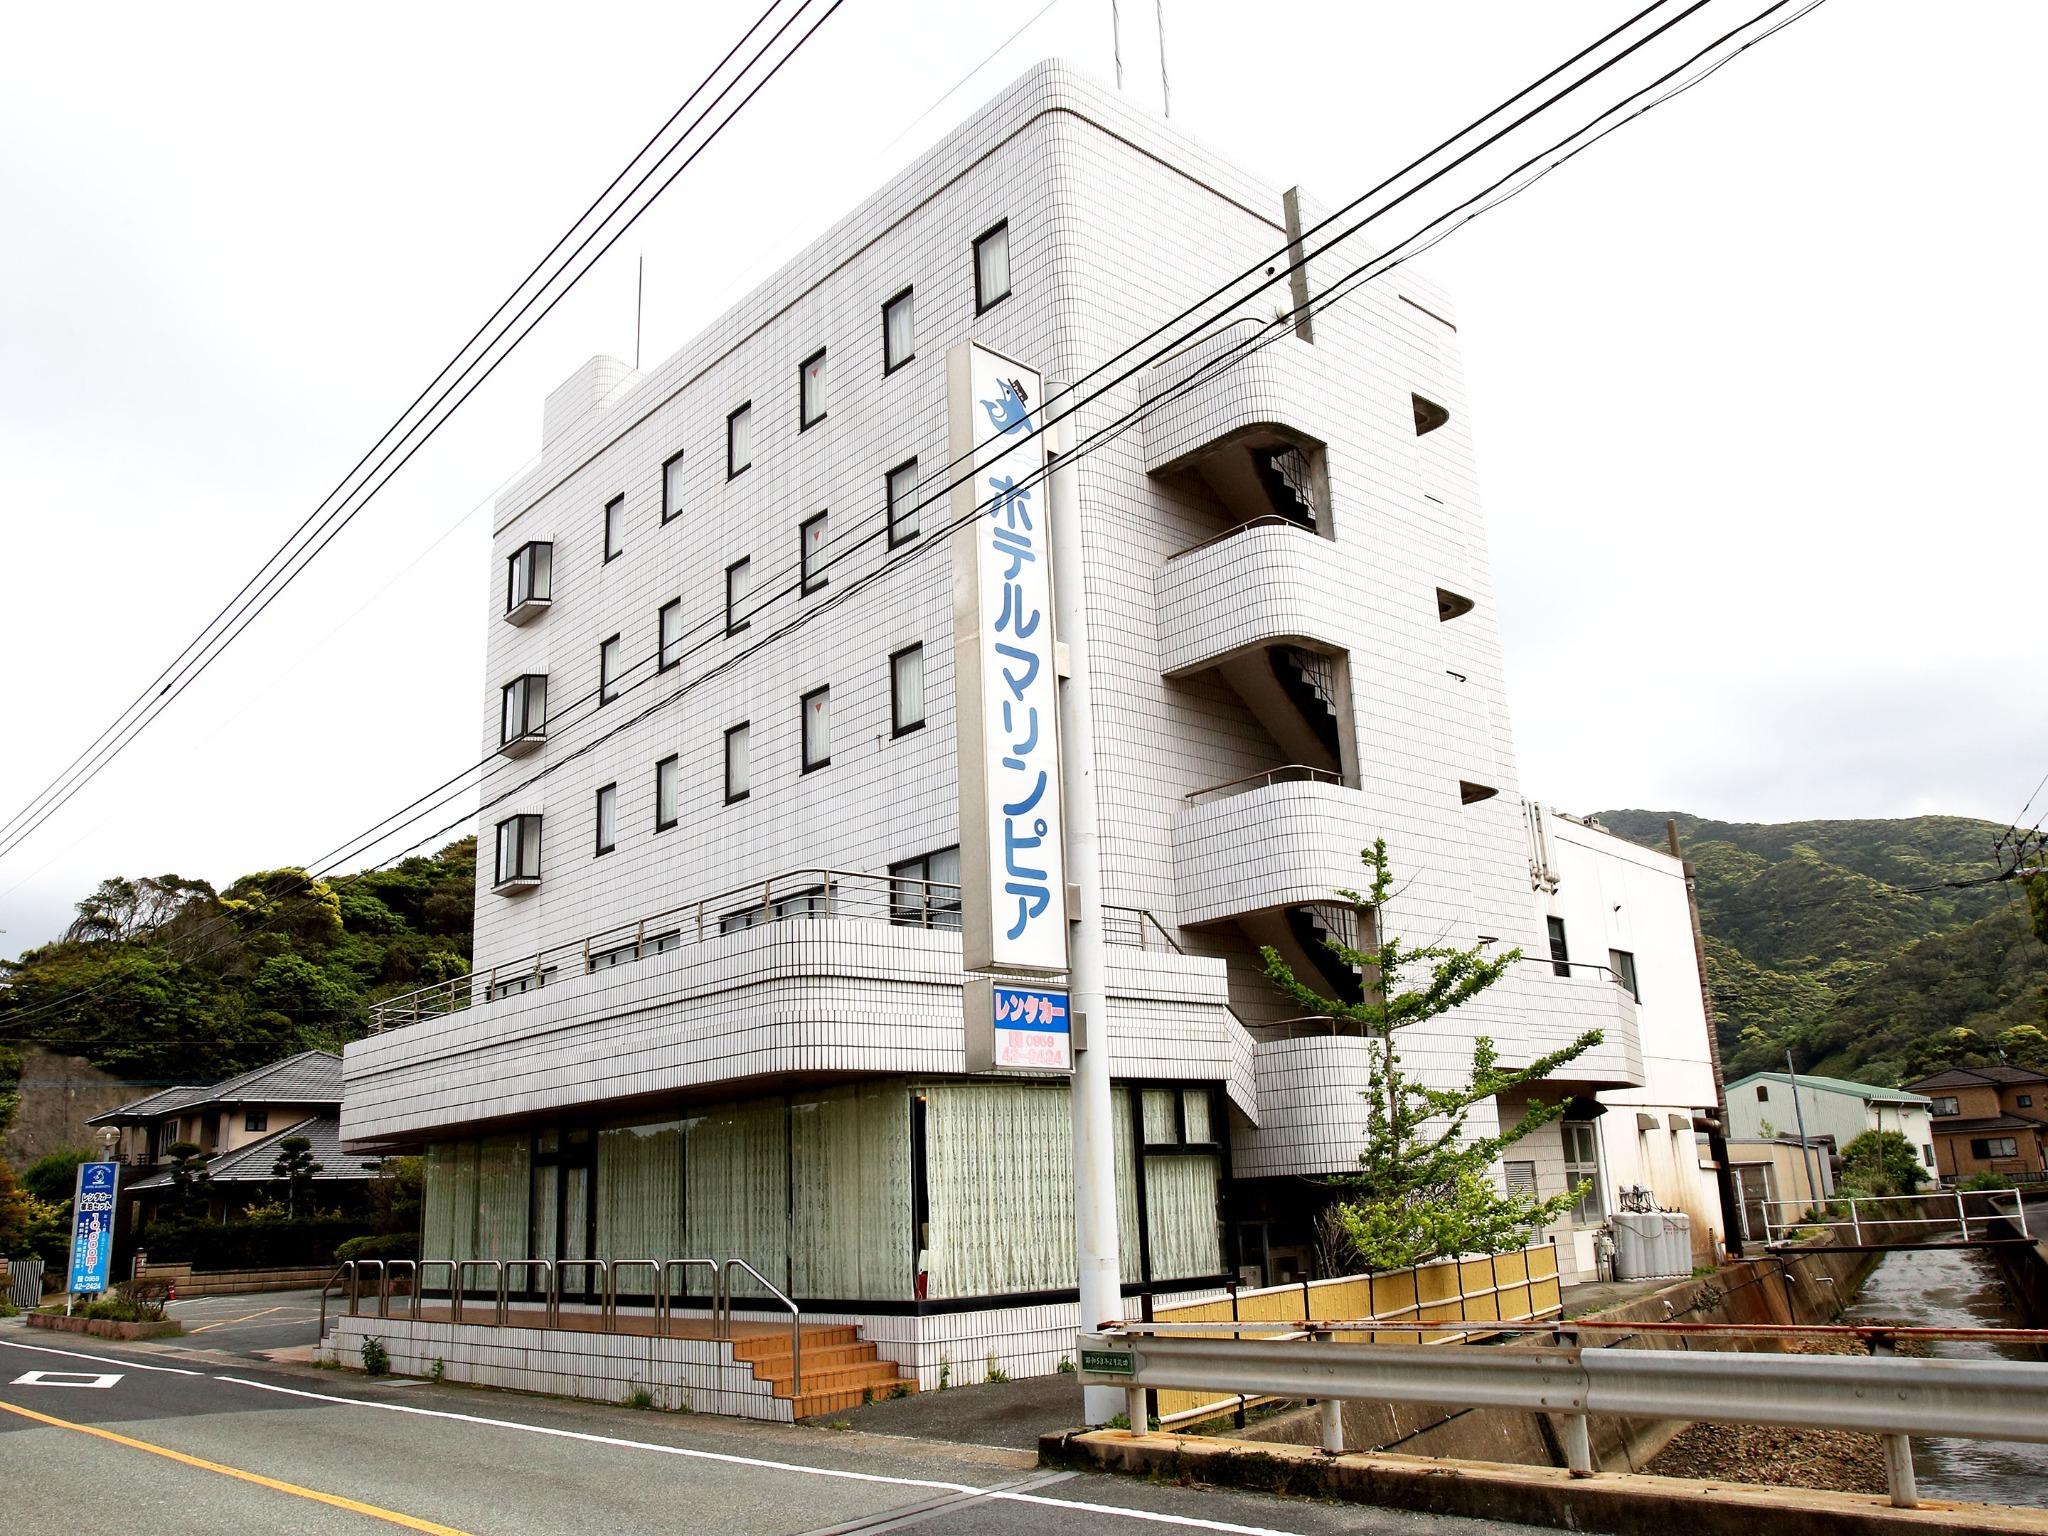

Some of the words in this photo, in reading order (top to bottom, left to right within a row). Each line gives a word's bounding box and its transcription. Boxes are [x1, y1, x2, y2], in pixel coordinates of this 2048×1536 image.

[989, 475, 1050, 940] ホテルマリンピア
[995, 992, 1065, 1024] レンタカー
[82, 1192, 112, 1204] レンタカー
